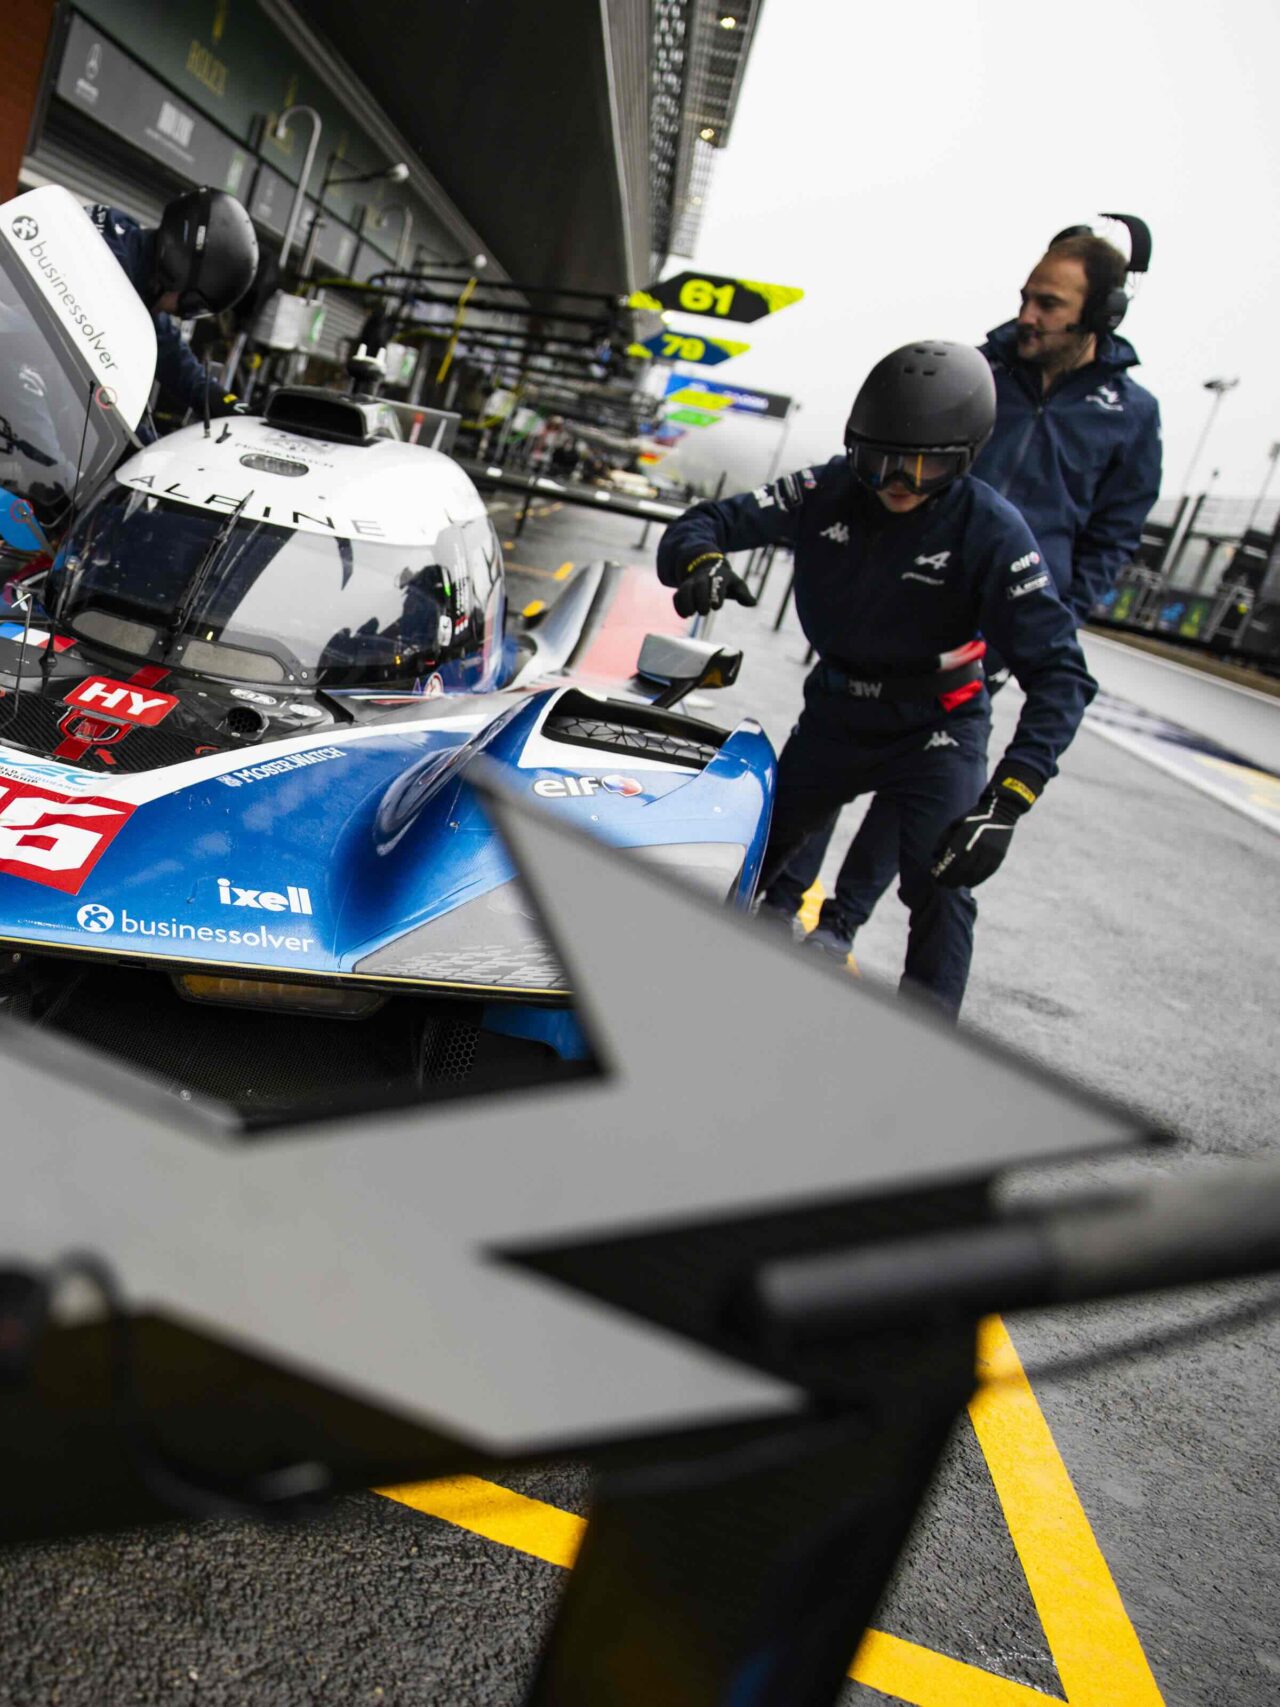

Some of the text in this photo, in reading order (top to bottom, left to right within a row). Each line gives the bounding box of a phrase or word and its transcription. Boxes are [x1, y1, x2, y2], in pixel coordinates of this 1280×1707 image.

[29, 240, 119, 371] businessolver
[679, 279, 735, 316] 61
[662, 333, 706, 361] 79
[129, 475, 386, 537] ALPINE
[78, 681, 168, 716] HY
[533, 776, 600, 798] elf
[217, 877, 314, 915] ixell
[121, 910, 315, 953] businessolver
